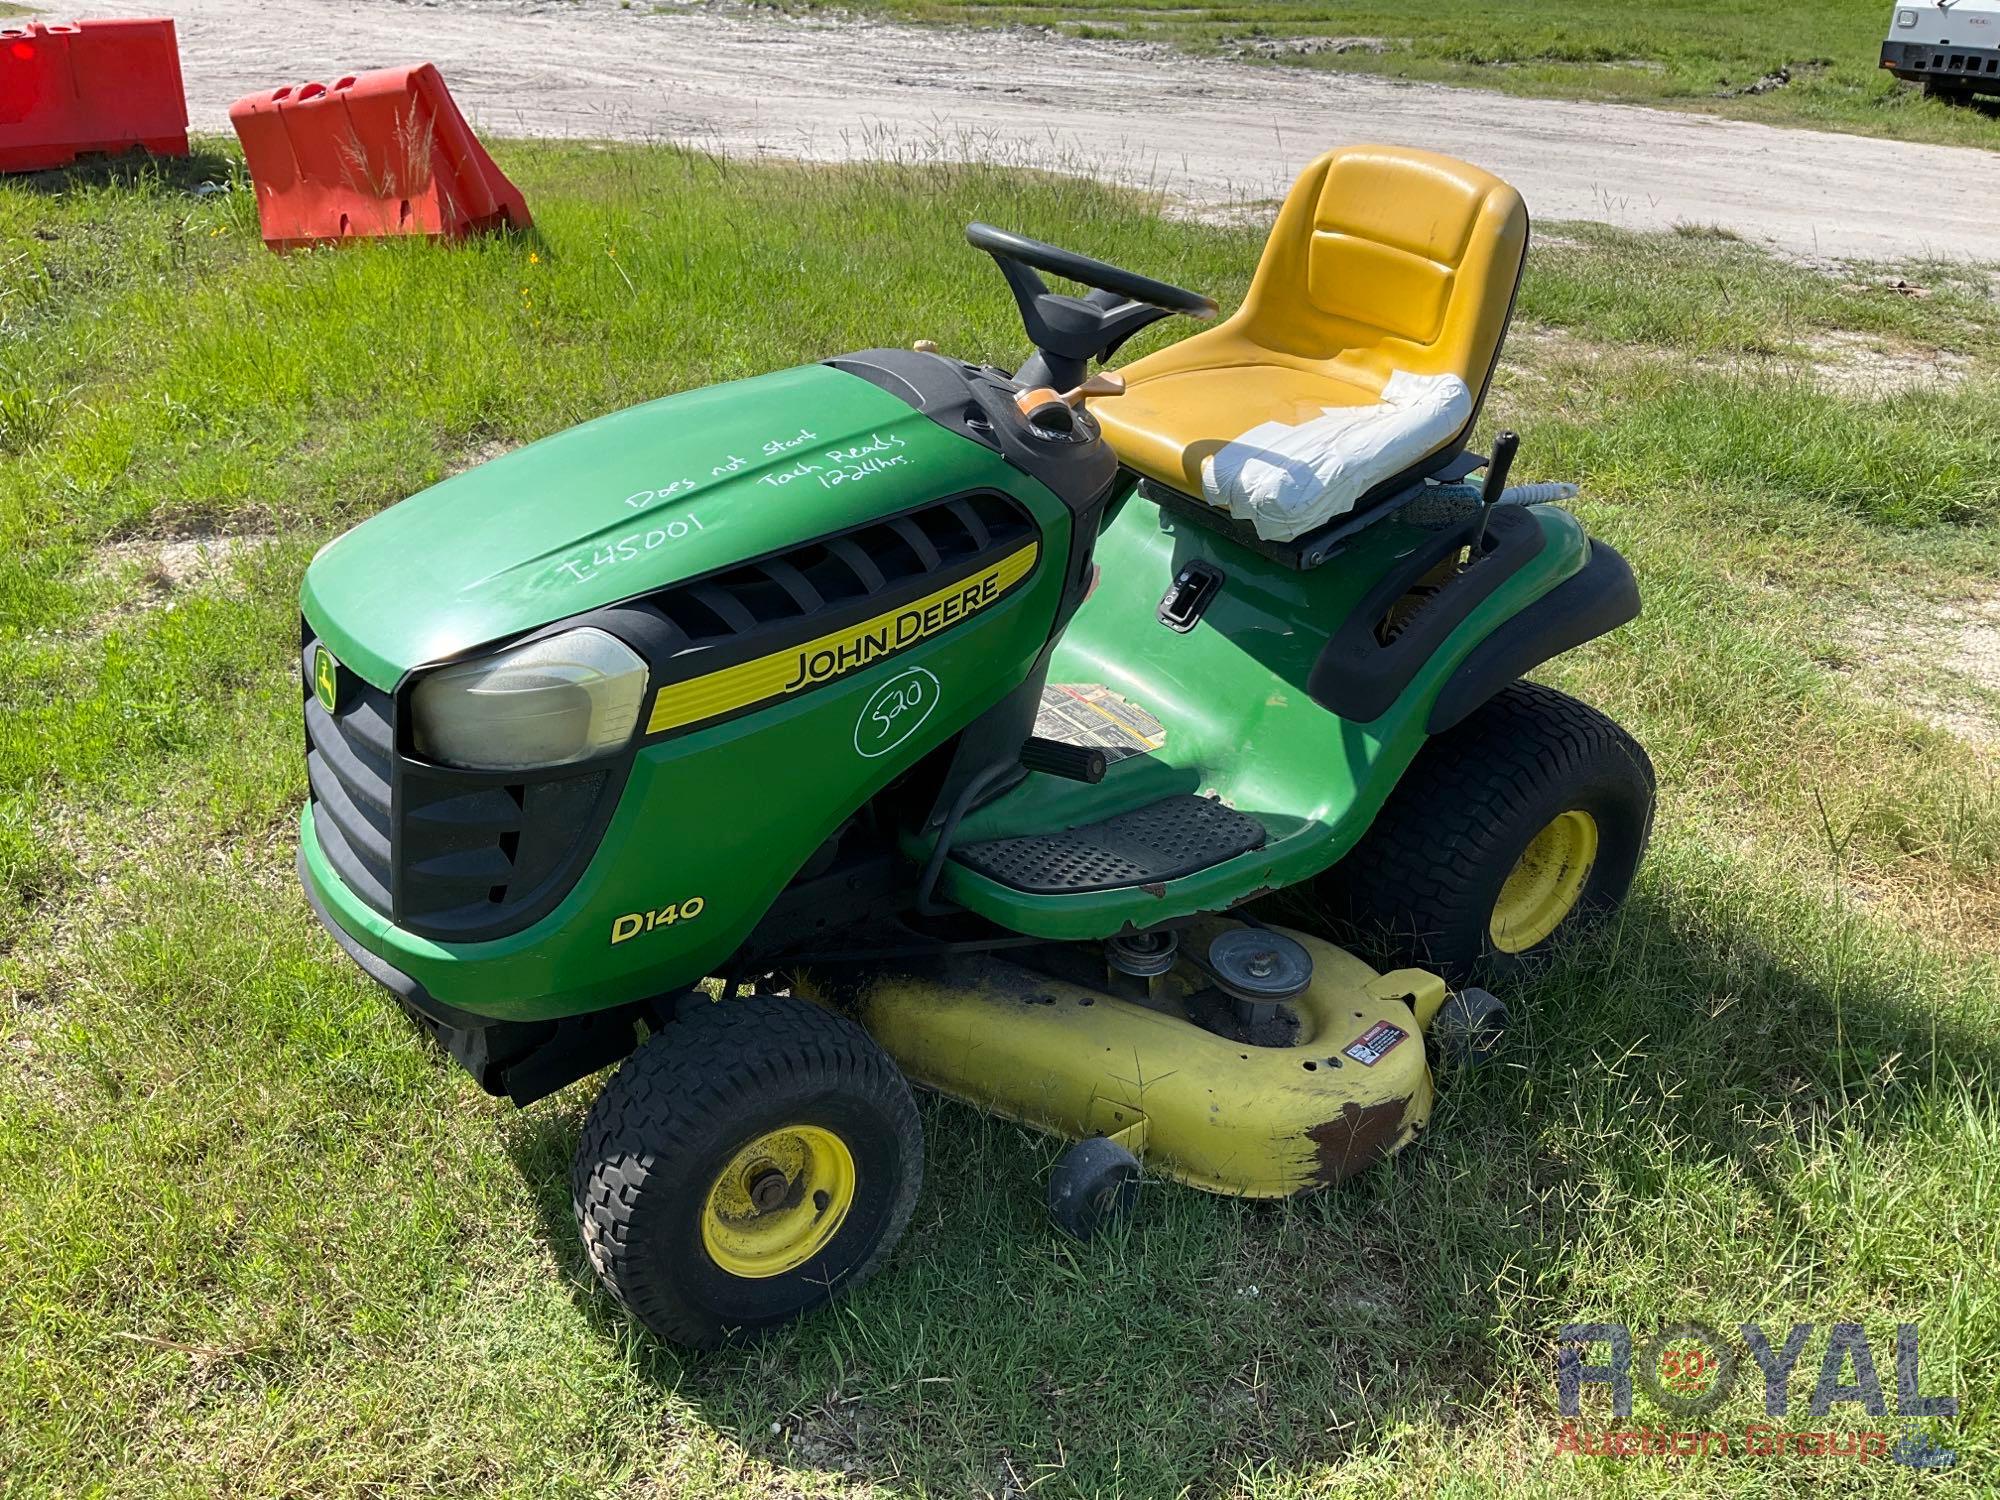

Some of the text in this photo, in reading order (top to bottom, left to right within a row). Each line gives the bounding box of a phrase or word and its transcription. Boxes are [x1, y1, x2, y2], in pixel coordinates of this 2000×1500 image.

[625, 478, 696, 507] Does
[711, 455, 747, 476] not
[756, 462, 823, 486] Tach
[785, 571, 999, 691] JOHN DEERE
[872, 680, 923, 740] 520
[610, 896, 705, 945] D140
